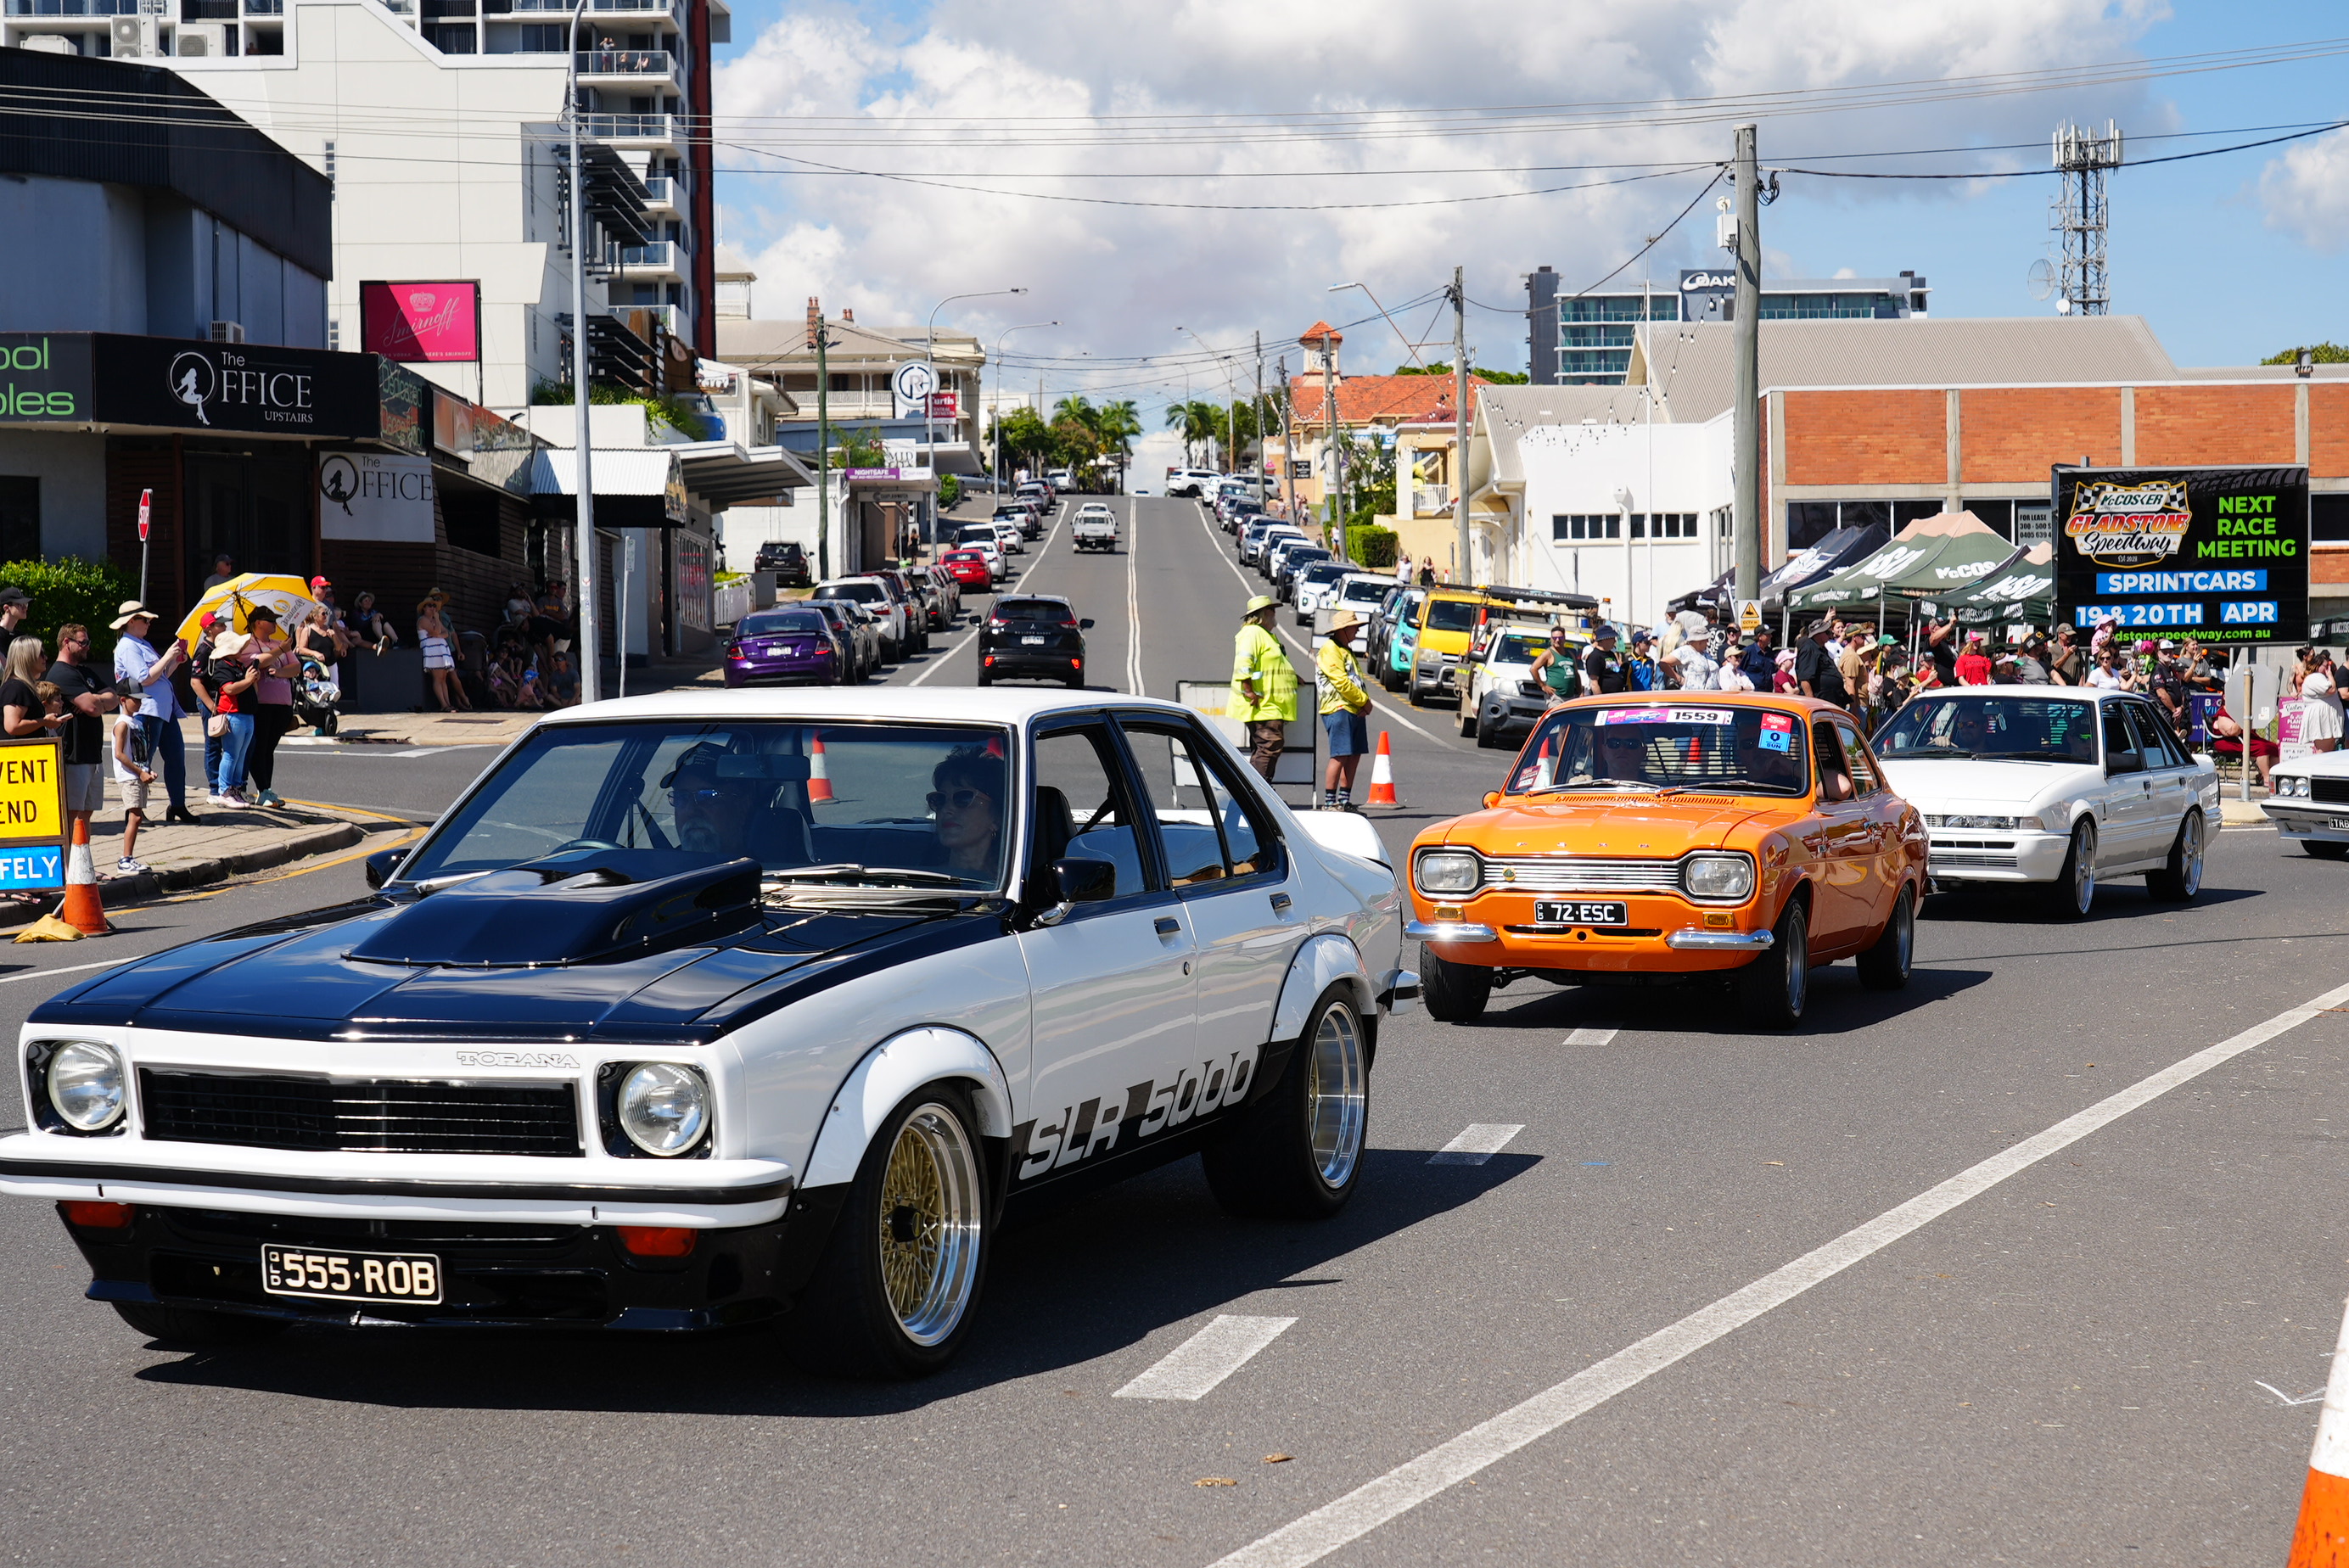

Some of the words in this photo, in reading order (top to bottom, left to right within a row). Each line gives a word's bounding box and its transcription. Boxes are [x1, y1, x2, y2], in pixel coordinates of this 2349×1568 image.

[382, 296, 461, 347] Smirnoff
[221, 351, 245, 367] The
[265, 411, 313, 423] UPSTAIRS
[362, 456, 380, 468] The
[2218, 496, 2277, 514] NEXT
[139, 506, 149, 524] STOP
[2066, 513, 2190, 535] GLADSTONE
[2217, 518, 2277, 536] RACE
[2084, 531, 2178, 557] Speedway
[2197, 538, 2296, 558] MEETING
[1936, 561, 2002, 579] McCOS
[2108, 571, 2256, 592] SPRINTCARS
[2133, 603, 2201, 625] 20TH
[2223, 602, 2275, 622] APR
[2256, 629, 2271, 638] au
[1674, 711, 1718, 721] 1559
[0, 800, 37, 826] ND
[457, 1050, 580, 1068] TORANA
[1018, 1087, 1130, 1180] SLR
[1138, 1044, 1259, 1138] 5000
